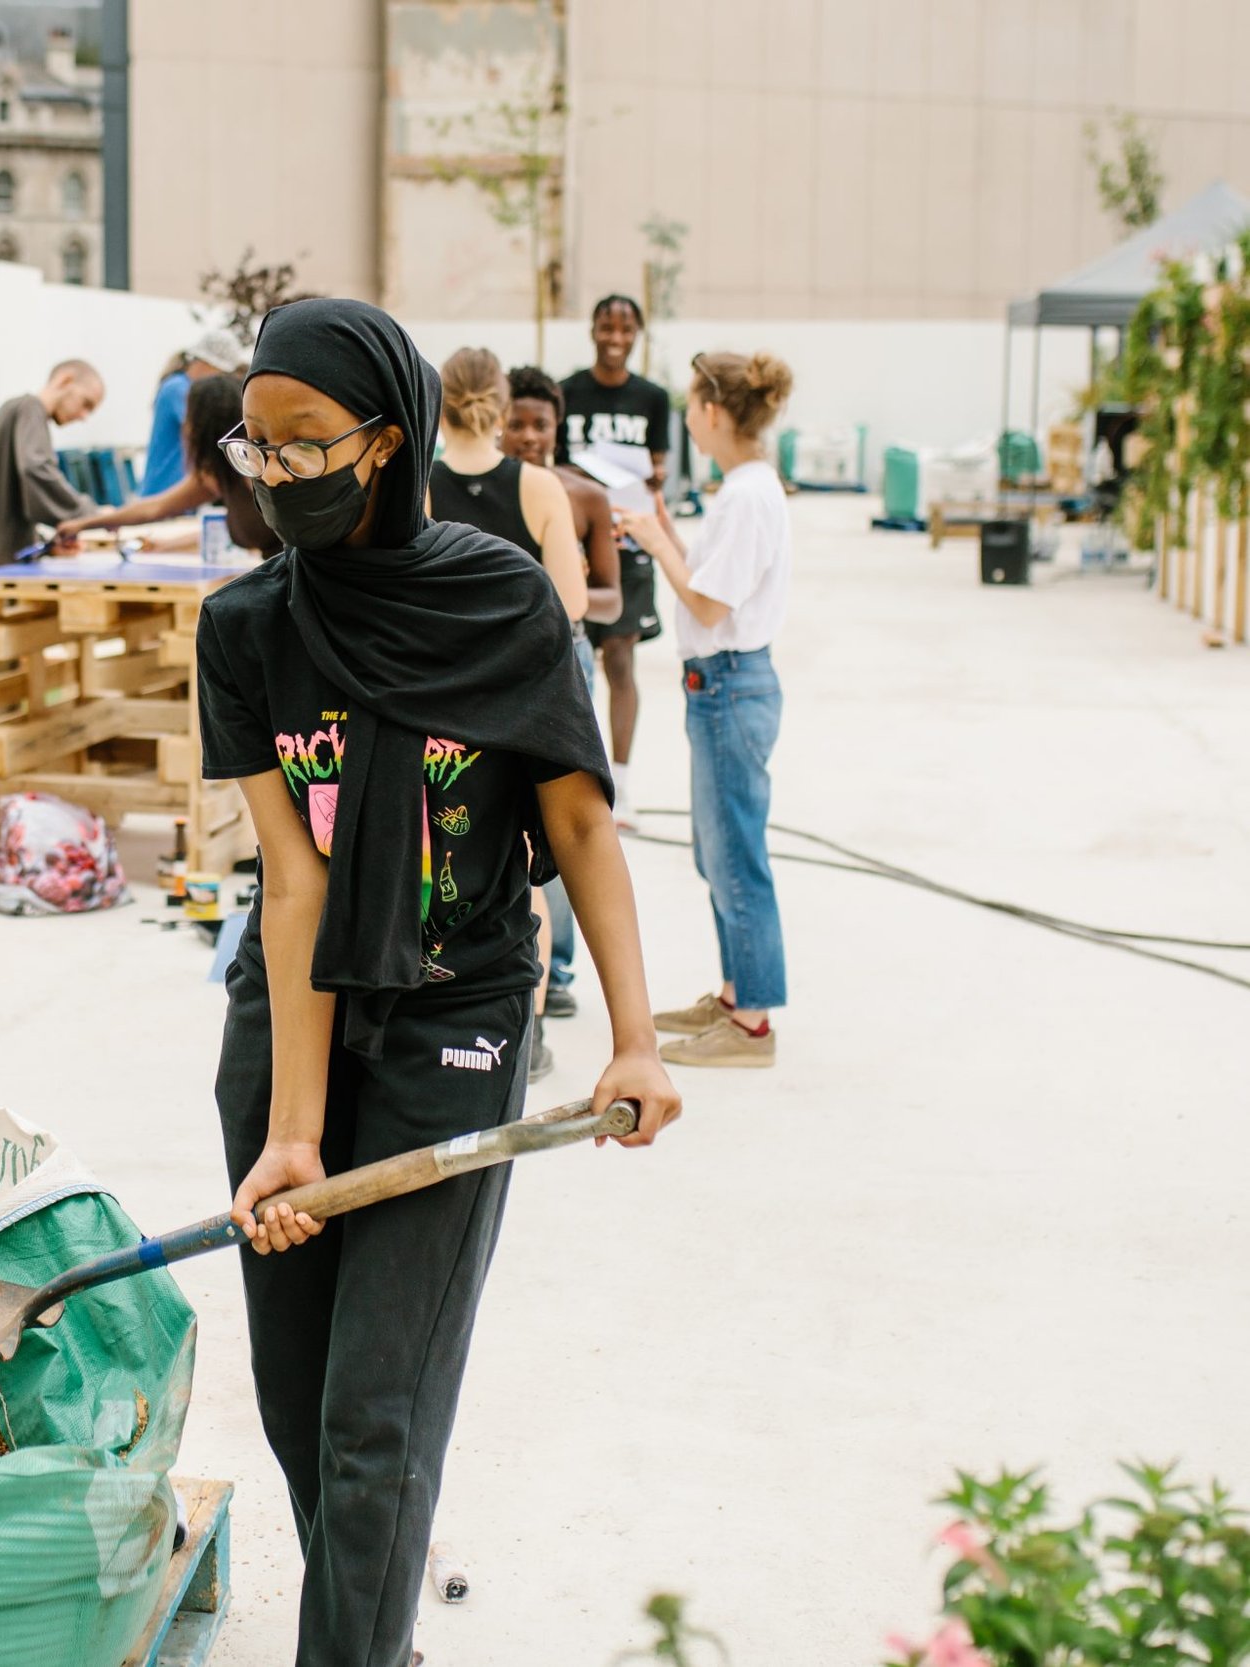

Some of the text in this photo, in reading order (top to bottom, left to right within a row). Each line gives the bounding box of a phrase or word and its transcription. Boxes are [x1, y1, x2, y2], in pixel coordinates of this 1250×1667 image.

[566, 412, 648, 445] I AM
[321, 710, 340, 721] THE
[441, 1047, 493, 1071] PUMA
